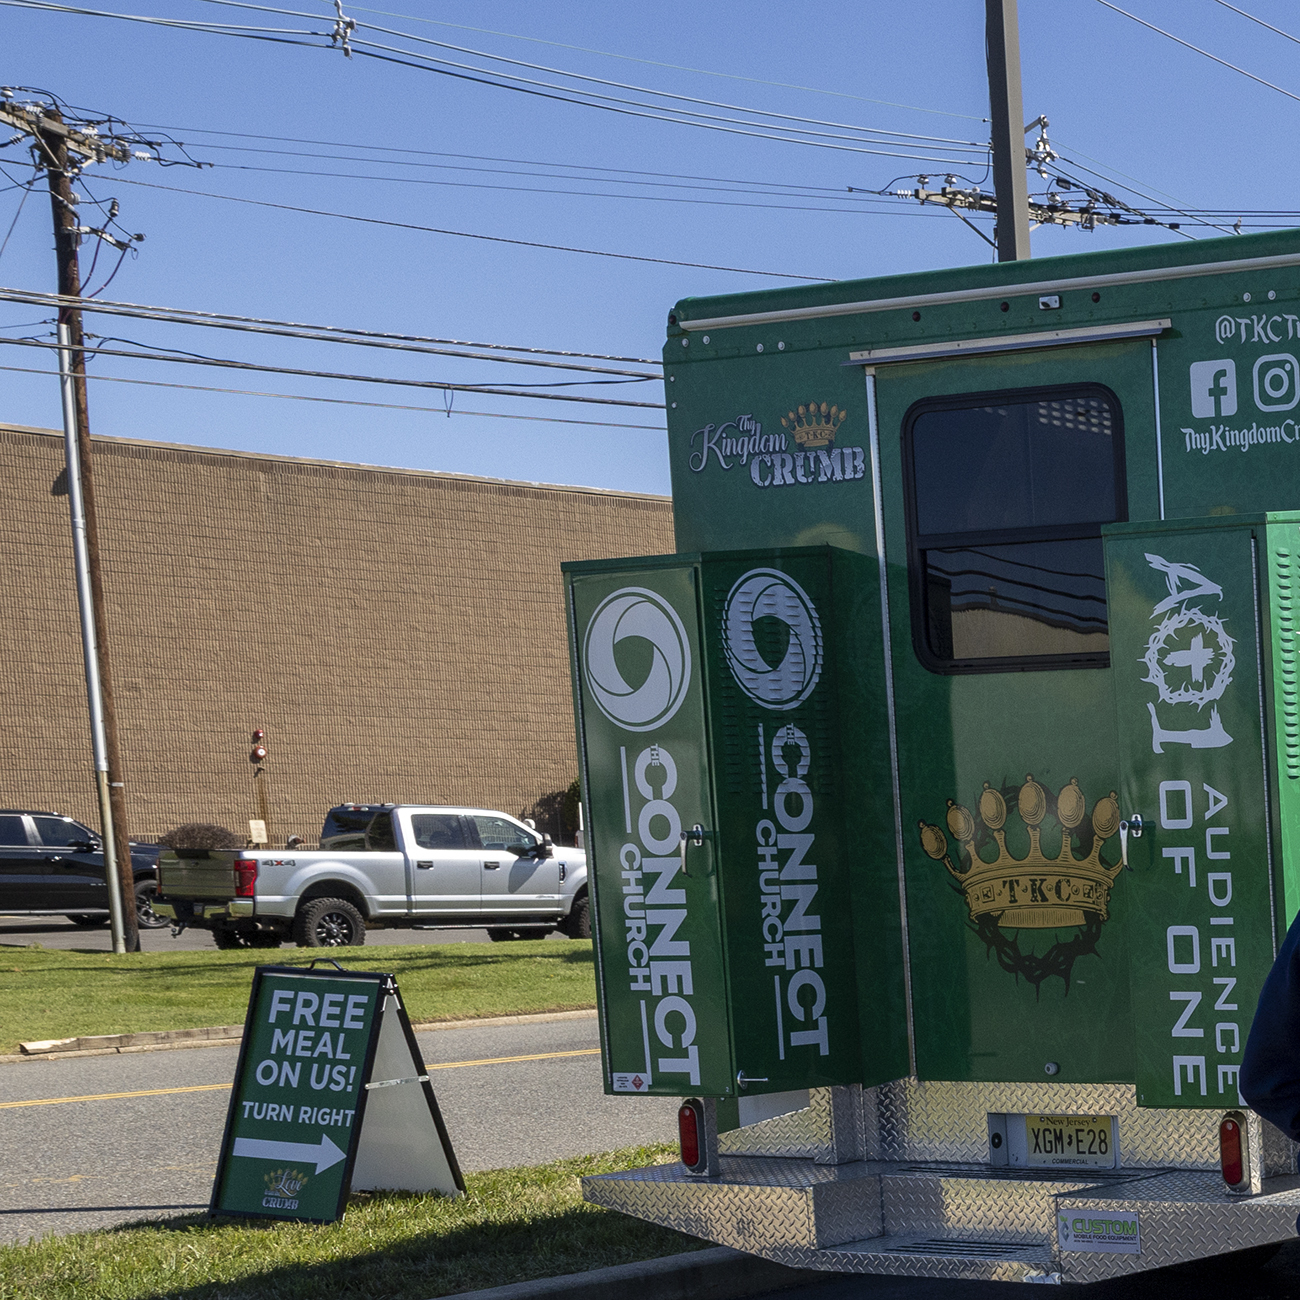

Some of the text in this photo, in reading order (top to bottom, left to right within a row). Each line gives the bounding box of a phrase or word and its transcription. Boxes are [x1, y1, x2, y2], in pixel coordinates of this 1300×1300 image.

[736, 414, 756, 435] Thy
[690, 422, 788, 472] Kingdom
[751, 447, 865, 486] CRUMB
[650, 743, 660, 767] THE
[755, 819, 786, 966] CHURCH
[771, 726, 829, 1056] CONNECT
[619, 842, 651, 991] CHURCH
[634, 746, 700, 1086] CONNECT
[1159, 780, 1207, 1096] OF ONE
[1203, 782, 1250, 1106] AUDIENCE
[268, 989, 369, 1030] FREE
[270, 1028, 351, 1060] MEAL
[255, 1059, 357, 1092] ON US!
[242, 1101, 356, 1128] TURN RIGHT
[1046, 1117, 1091, 1128] New Jersey
[1031, 1128, 1109, 1155] XGM E28
[262, 1196, 299, 1210] CRUMB
[1072, 1218, 1138, 1236] CUSTOM
